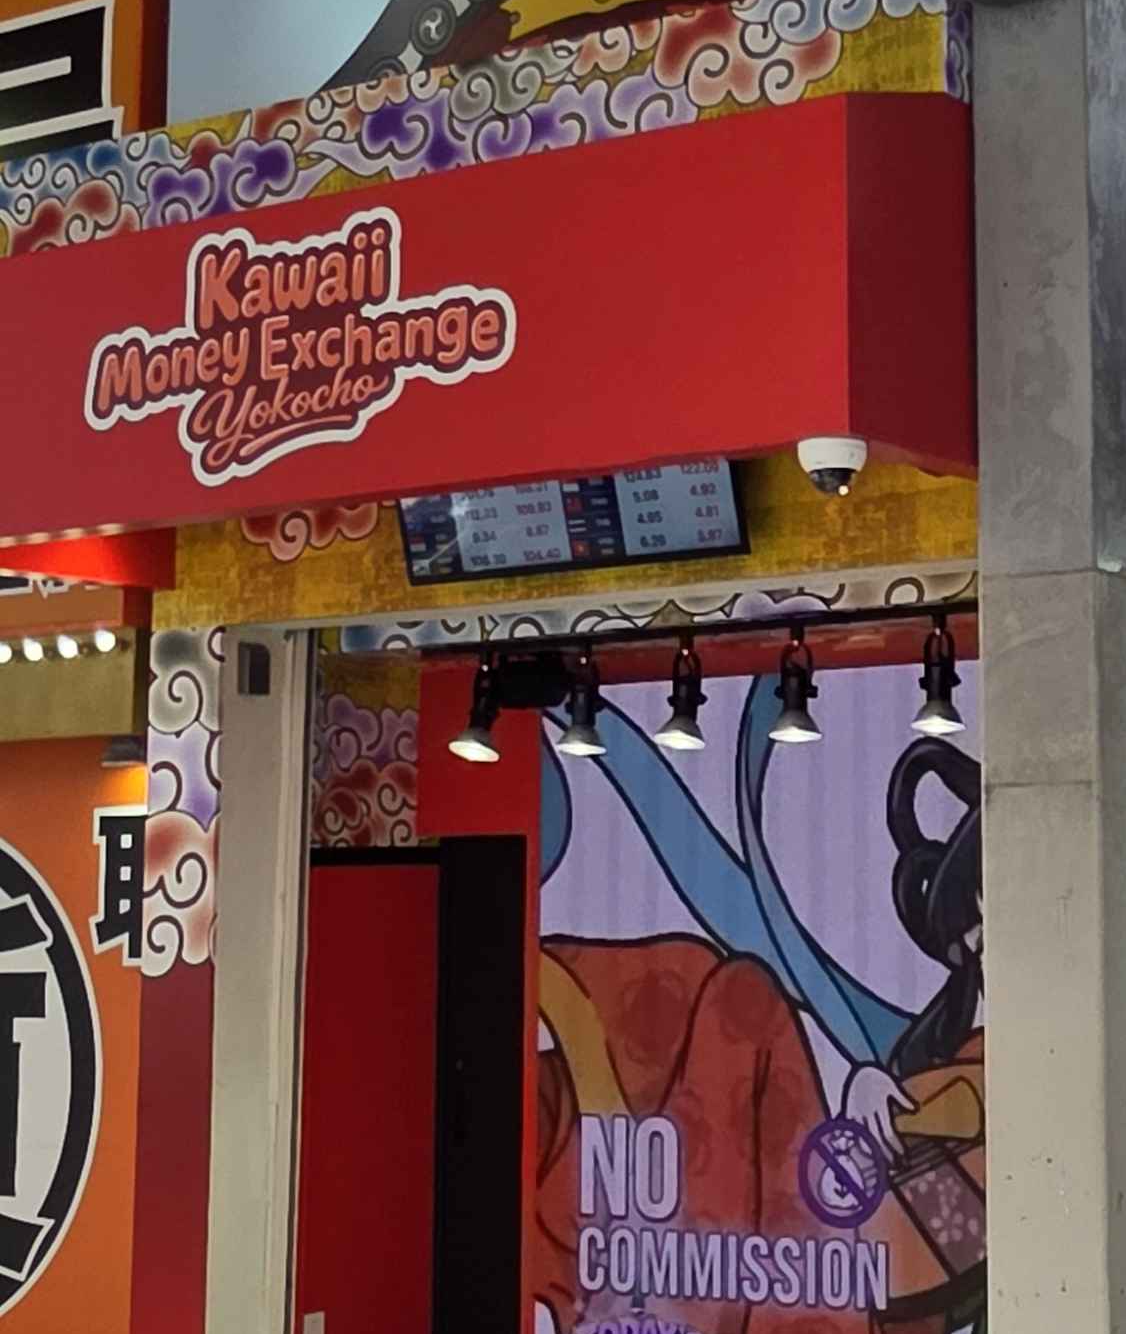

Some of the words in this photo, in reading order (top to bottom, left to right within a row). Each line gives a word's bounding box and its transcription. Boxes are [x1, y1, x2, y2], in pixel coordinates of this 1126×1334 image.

[199, 227, 388, 329] Kawaii
[98, 327, 249, 410] Money
[260, 303, 500, 381] Exchange
[193, 367, 390, 467] Yokocho
[579, 1114, 680, 1220] NO
[577, 1226, 889, 1311] COMMISSION
